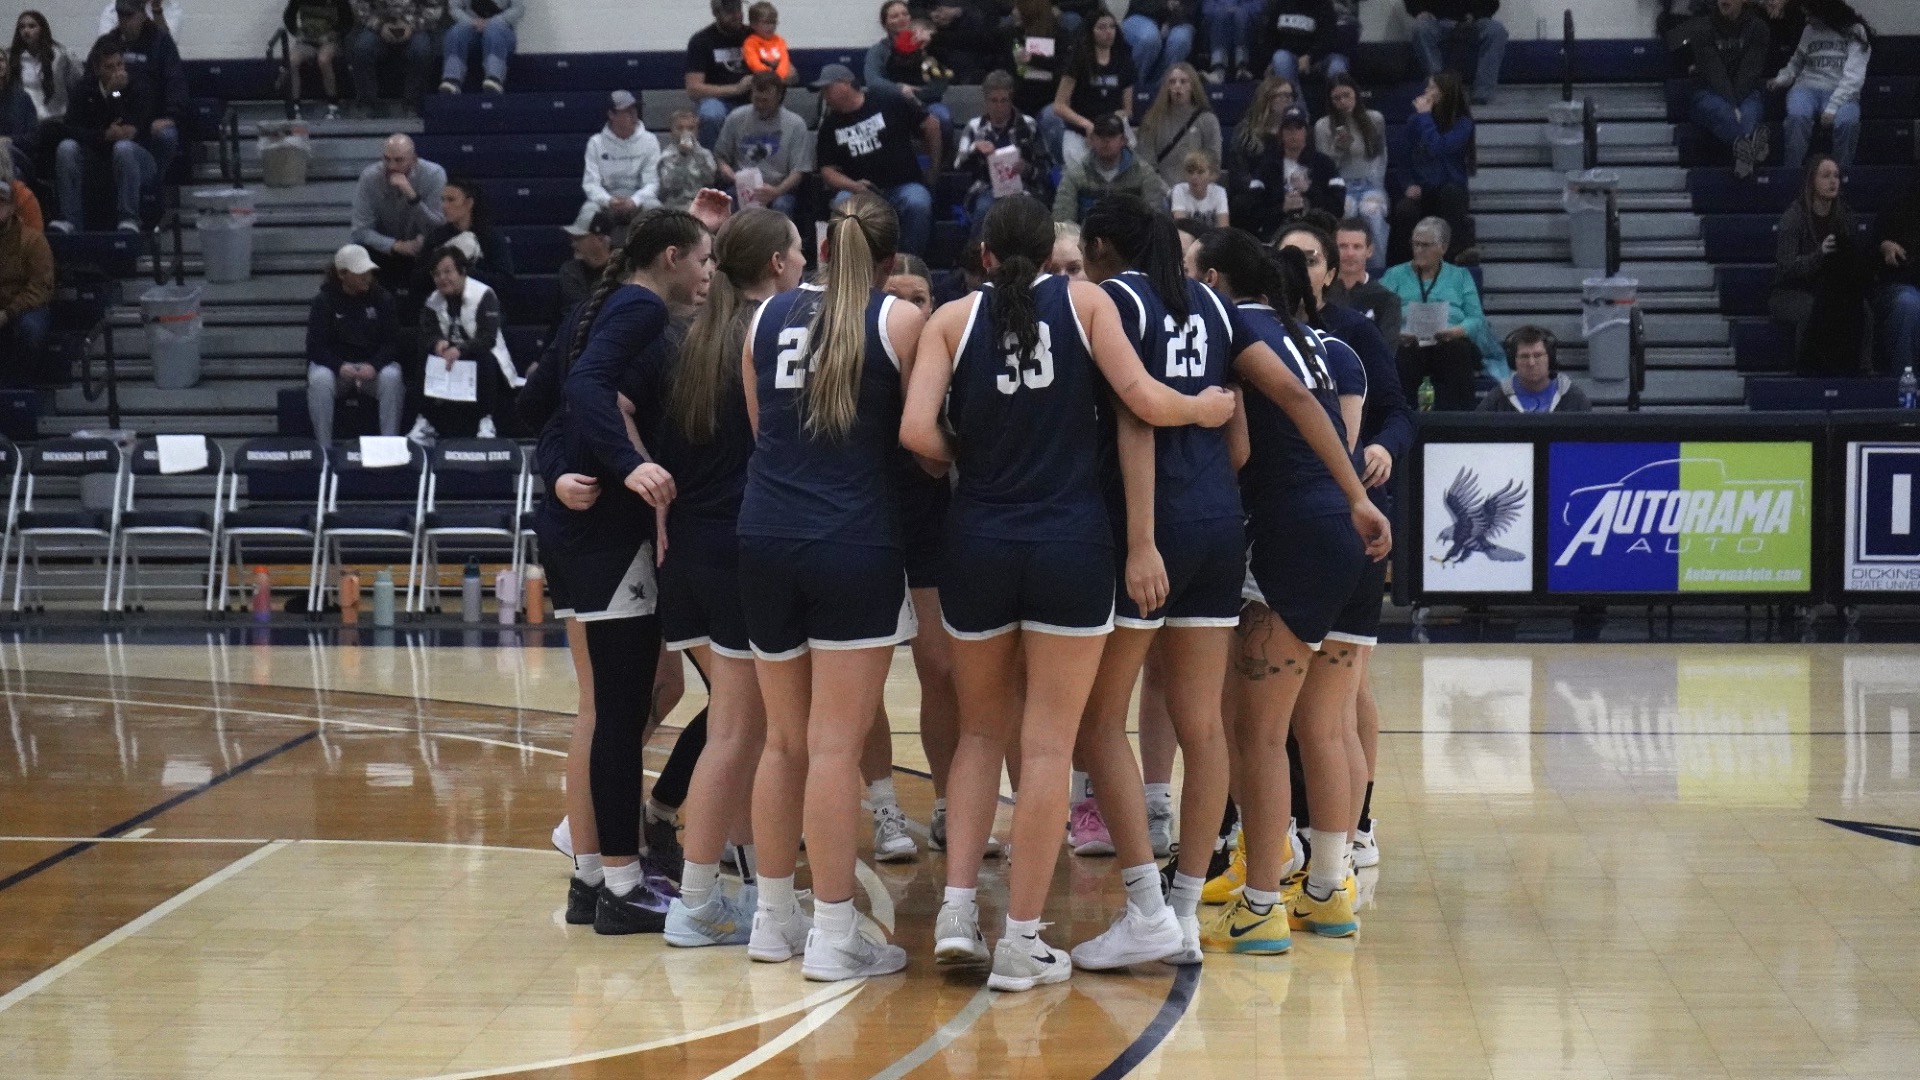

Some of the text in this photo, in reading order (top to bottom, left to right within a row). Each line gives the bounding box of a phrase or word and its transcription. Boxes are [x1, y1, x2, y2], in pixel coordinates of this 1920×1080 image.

[848, 136, 882, 157] STATE
[1164, 314, 1208, 377] 23
[775, 327, 824, 389] 2
[996, 320, 1054, 394] 33
[86, 450, 107, 460] STATE
[289, 449, 312, 460] STATE
[488, 450, 510, 461] STATE
[1554, 489, 1794, 566] AUTORAMA
[1626, 537, 1764, 553] AUTO
[1850, 580, 1883, 590] STATE
